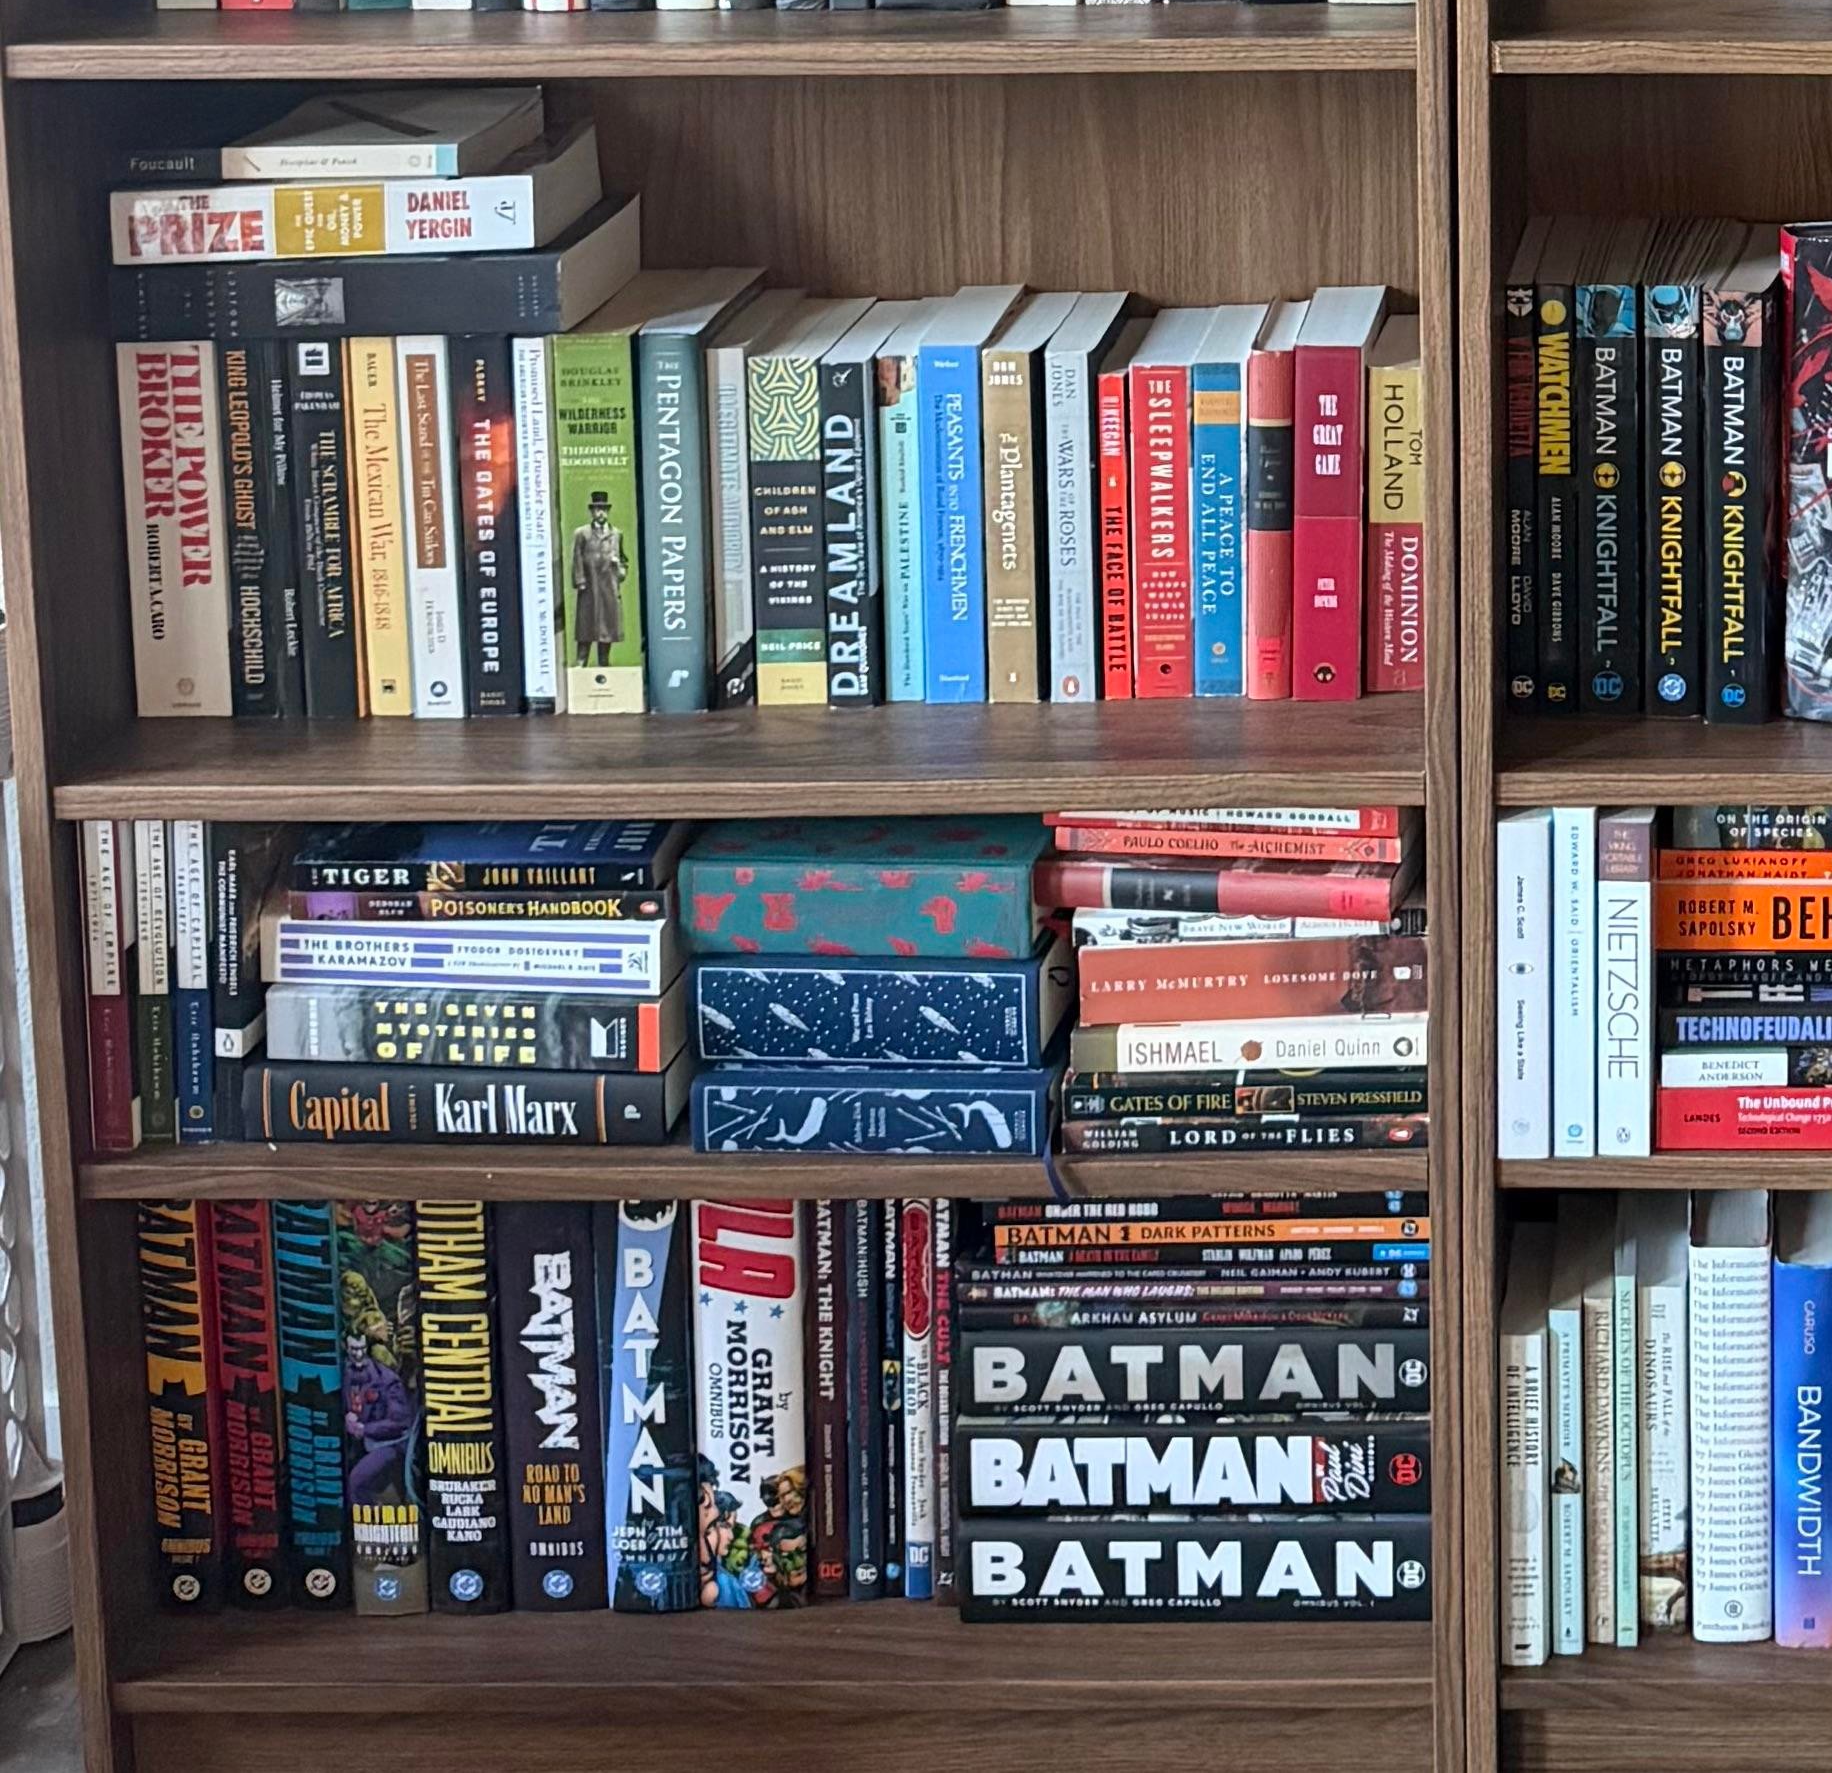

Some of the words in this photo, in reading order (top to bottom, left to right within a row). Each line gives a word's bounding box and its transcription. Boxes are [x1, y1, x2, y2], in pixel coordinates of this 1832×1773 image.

[130, 157, 195, 171] Foucault
[406, 218, 472, 239] YERGIN
[407, 192, 470, 213] DANIEL
[1538, 333, 1572, 474] WATCHMEN
[1722, 356, 1747, 468] BATMAN
[656, 373, 684, 524] PENTAGON
[1148, 398, 1175, 560] SLEEPWALKERS
[660, 534, 687, 632] PAPERS
[825, 413, 861, 698] DREAMLAND
[1722, 505, 1746, 663] KNIGHTFALL
[1399, 535, 1419, 664] DOMINION
[323, 868, 410, 886] TIGER
[528, 898, 622, 917] HANDBOOK
[1677, 900, 1734, 917] ROBERT
[1740, 900, 1758, 915] M.
[1677, 920, 1756, 938] SAPOLSKY
[1607, 897, 1639, 1079] NIETZSCHE
[1128, 1041, 1223, 1064] ISHMAEL
[1276, 1039, 1326, 1057] Daniel
[1335, 1038, 1381, 1055] Quinn
[289, 1082, 391, 1139] Capital
[434, 1085, 500, 1134] Karl
[504, 1085, 578, 1136] Marx
[1110, 1096, 1164, 1112] GATES
[1168, 1095, 1189, 1110] OF
[1196, 1095, 1231, 1109] FIRE
[1298, 1093, 1346, 1105] STEVEN
[1350, 1091, 1421, 1104] PRESSFIELD
[1071, 1310, 1133, 1324] ARKHAM
[1138, 1310, 1197, 1323] ASYLUM
[725, 1318, 752, 1485] MORRISON
[752, 1347, 775, 1458] GRANT
[971, 1436, 1313, 1506] BATMAN
[1796, 1385, 1823, 1576] BANDWIDTH
